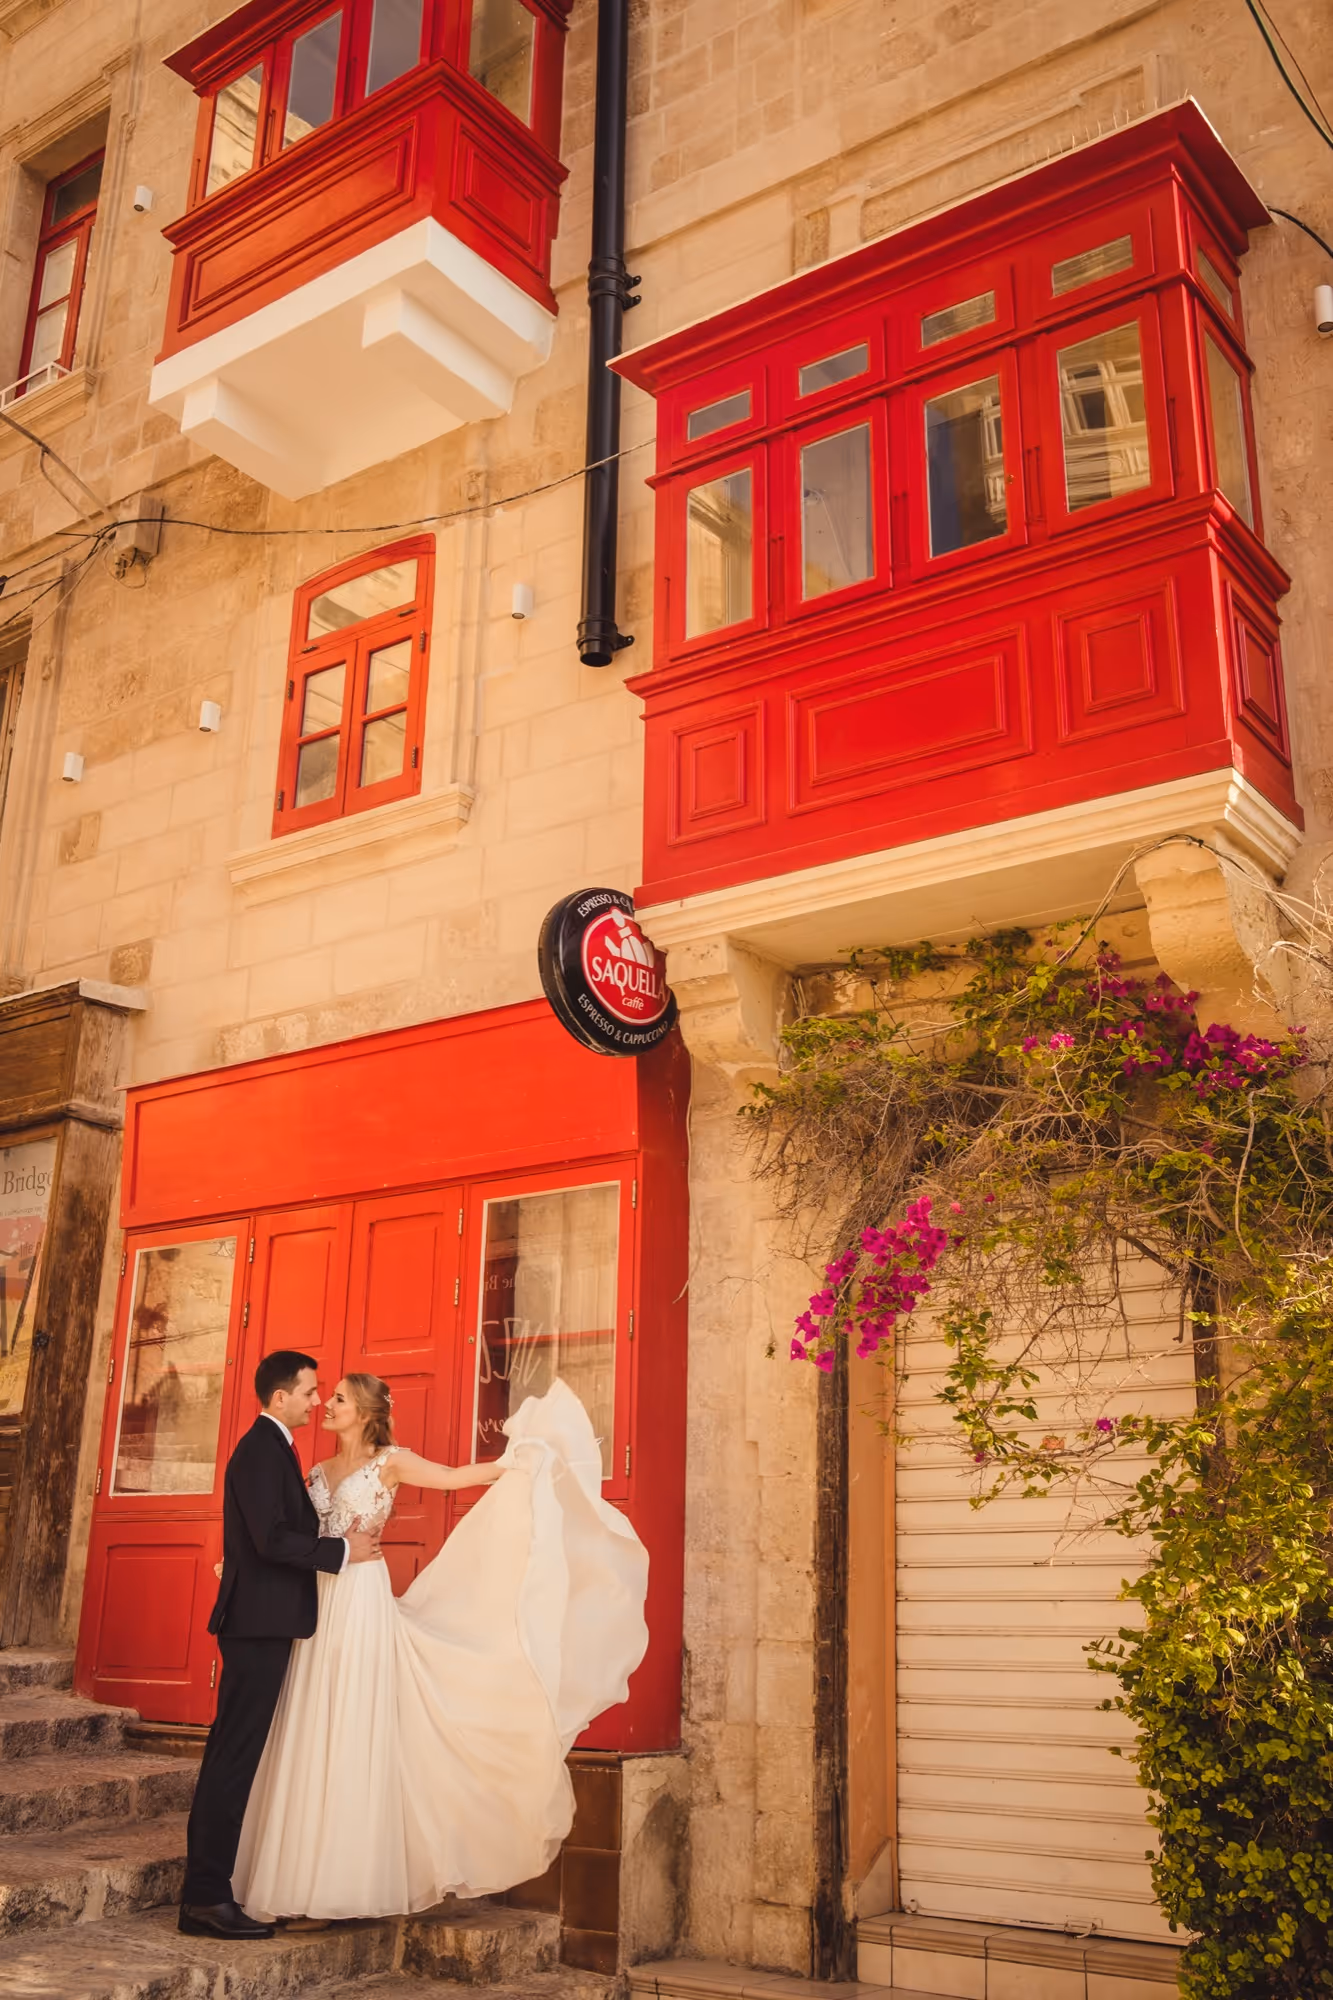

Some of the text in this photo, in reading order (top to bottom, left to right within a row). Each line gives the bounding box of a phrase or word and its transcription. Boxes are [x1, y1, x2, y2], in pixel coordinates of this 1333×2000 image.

[577, 893, 612, 918] ESPRESSO
[591, 956, 667, 1003] SAQUELLA
[577, 993, 615, 1036] ESPRESSO
[614, 1029, 622, 1041] &
